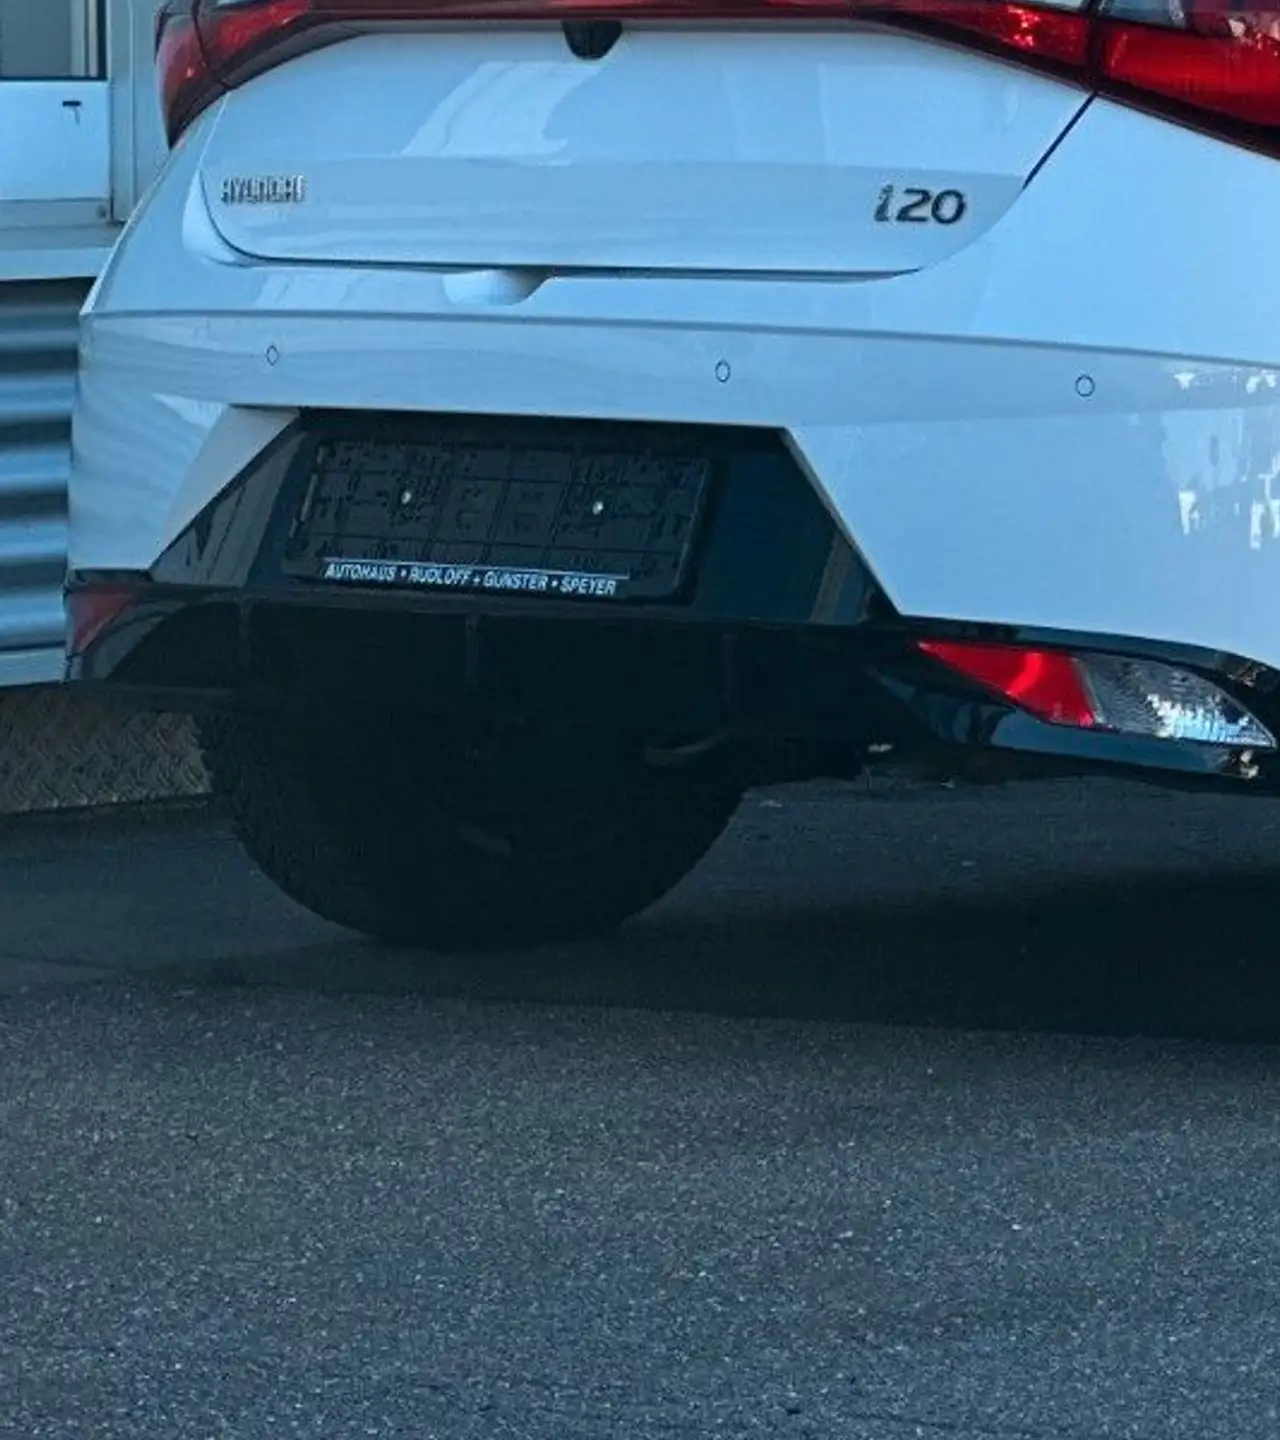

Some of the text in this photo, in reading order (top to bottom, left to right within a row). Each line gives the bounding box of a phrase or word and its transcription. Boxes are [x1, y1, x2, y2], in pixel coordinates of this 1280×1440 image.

[874, 184, 967, 226] i20
[324, 563, 397, 582] AUTOHAUS
[560, 575, 617, 597] SPEYER
